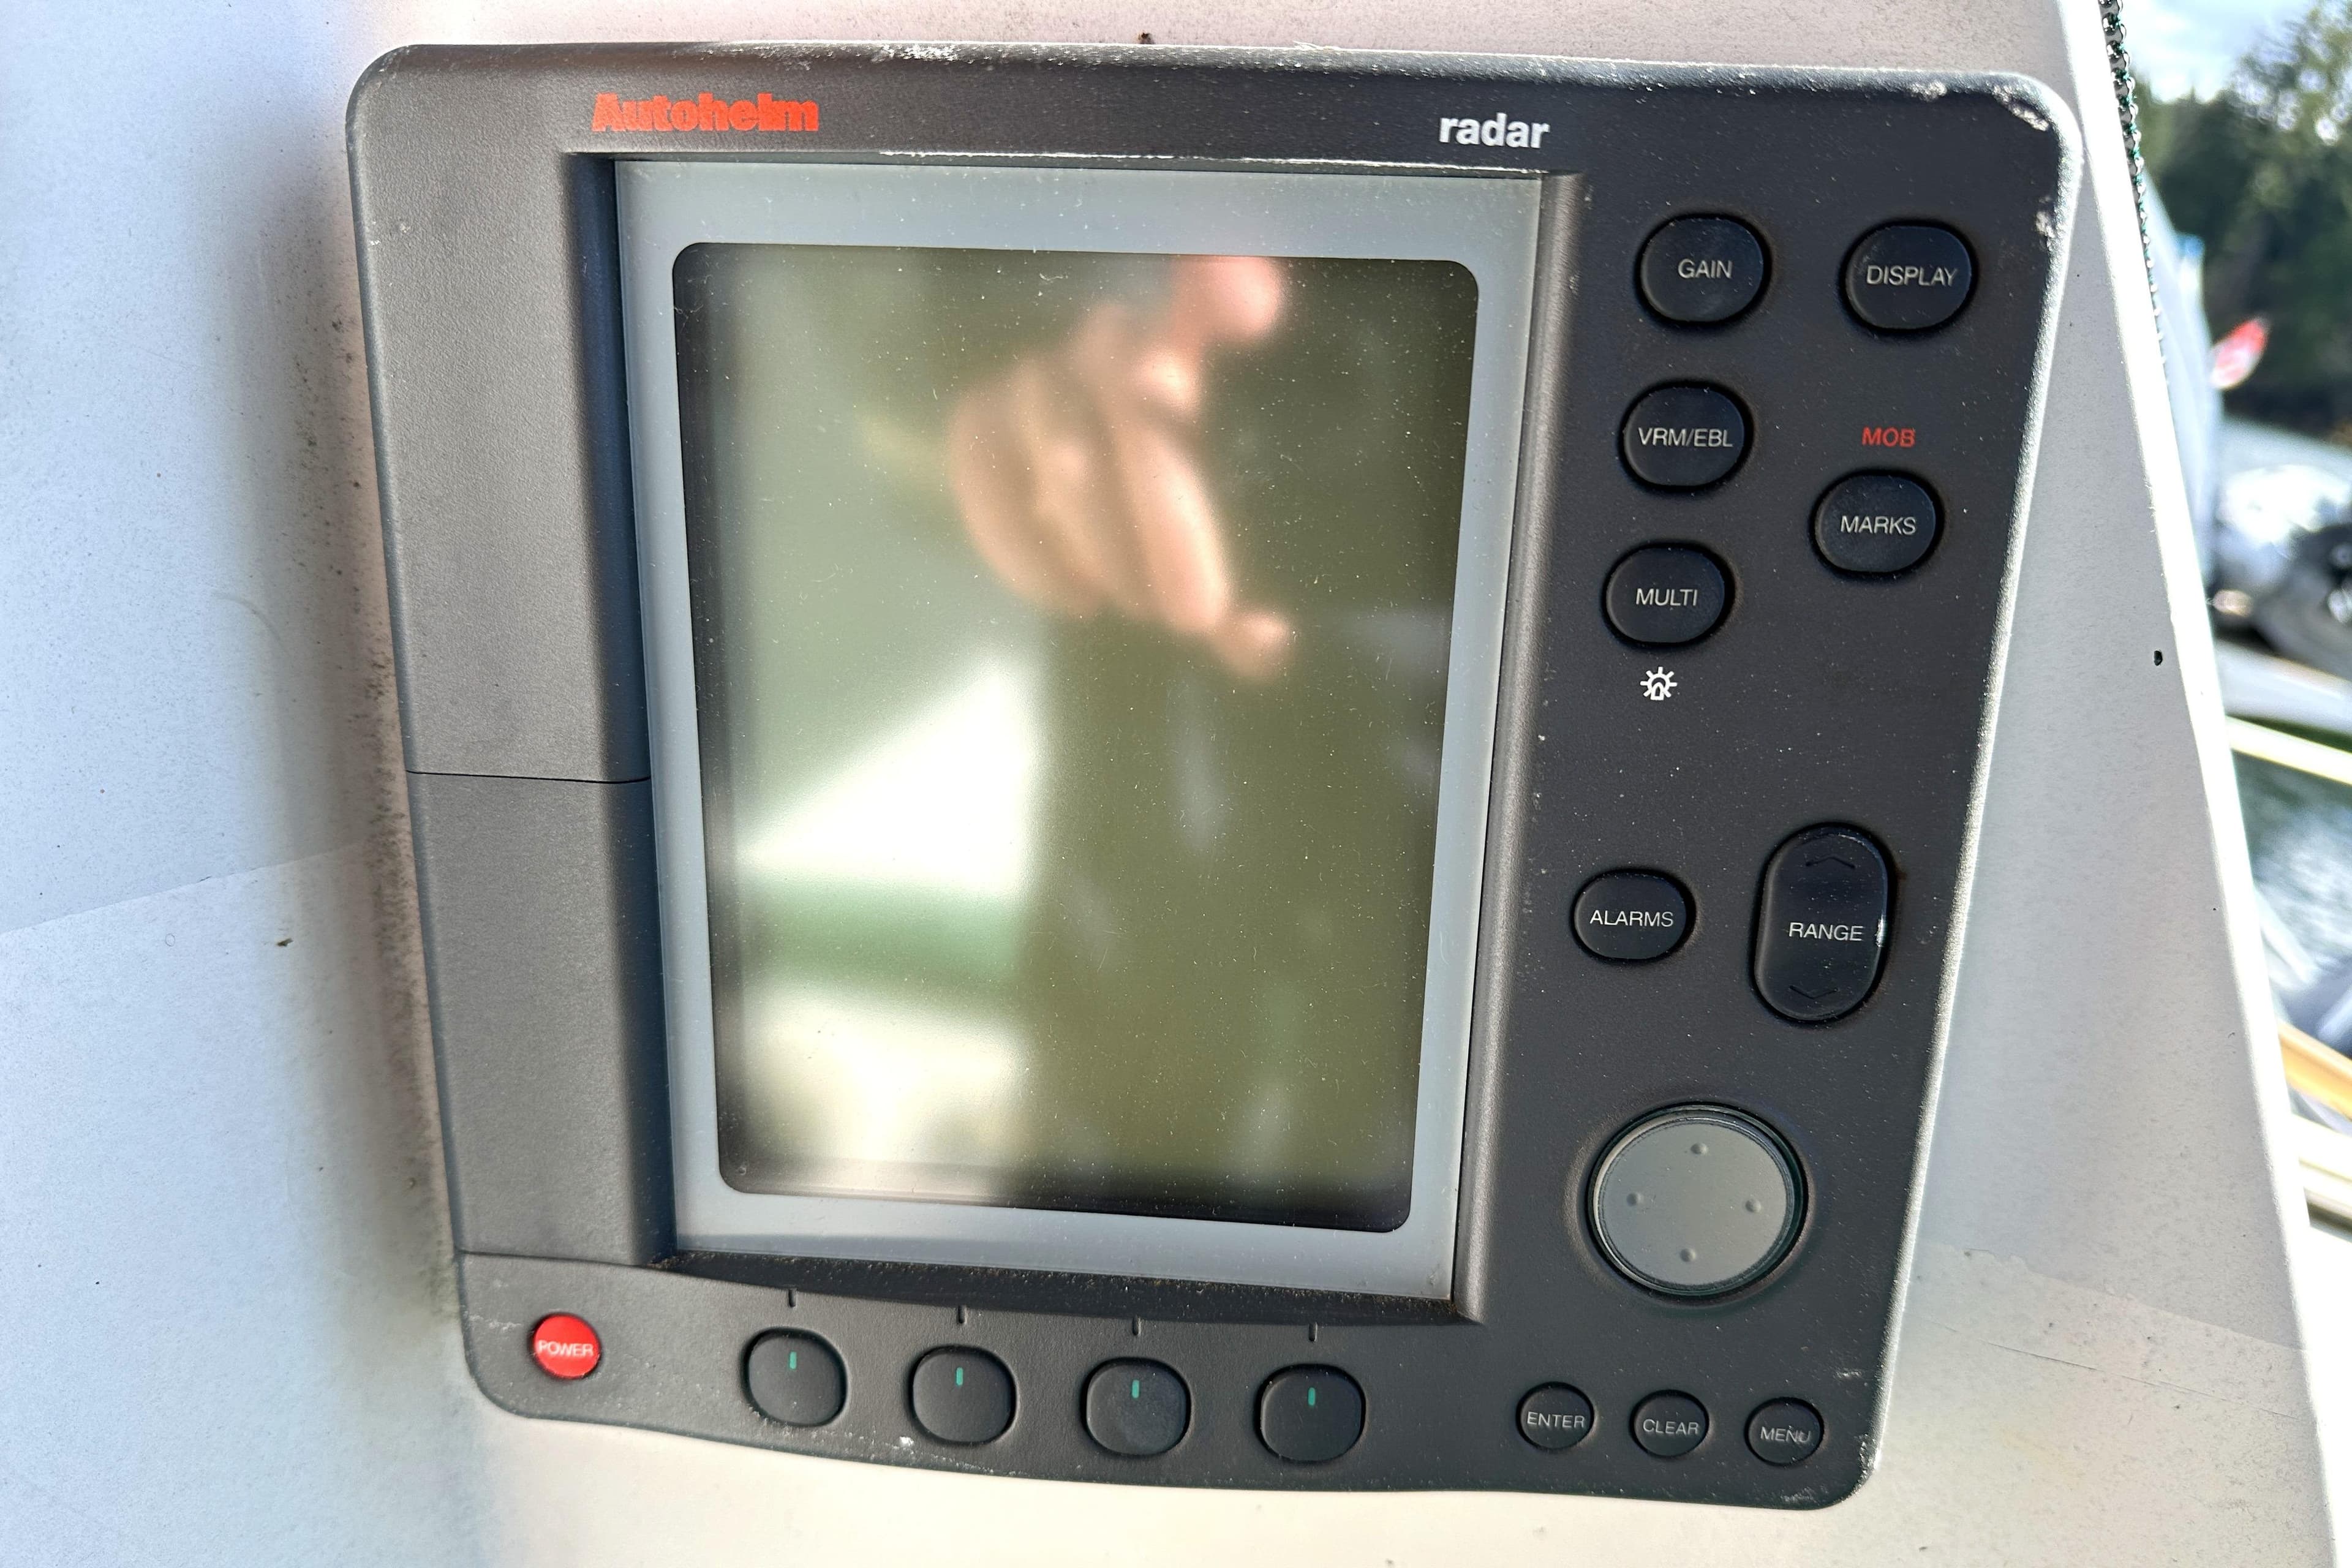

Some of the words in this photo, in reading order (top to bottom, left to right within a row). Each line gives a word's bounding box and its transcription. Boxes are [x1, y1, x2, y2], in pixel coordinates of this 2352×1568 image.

[592, 92, 821, 133] Autohelm
[1439, 113, 1550, 149] radar
[1678, 259, 1732, 279] GAIN
[1866, 266, 1958, 286] DISPLAY
[1638, 427, 1733, 448] VRM/EBL
[1861, 426, 1916, 448] MOB
[1839, 515, 1917, 535] MARKS
[1635, 587, 1698, 606] MULTI
[1588, 909, 1674, 928] ALARMS
[1787, 922, 1863, 942] RANGE
[536, 1340, 594, 1357] POWER
[1526, 1411, 1585, 1428] ENTER
[1642, 1418, 1699, 1435] CLEAR
[1760, 1425, 1811, 1444] MENU
